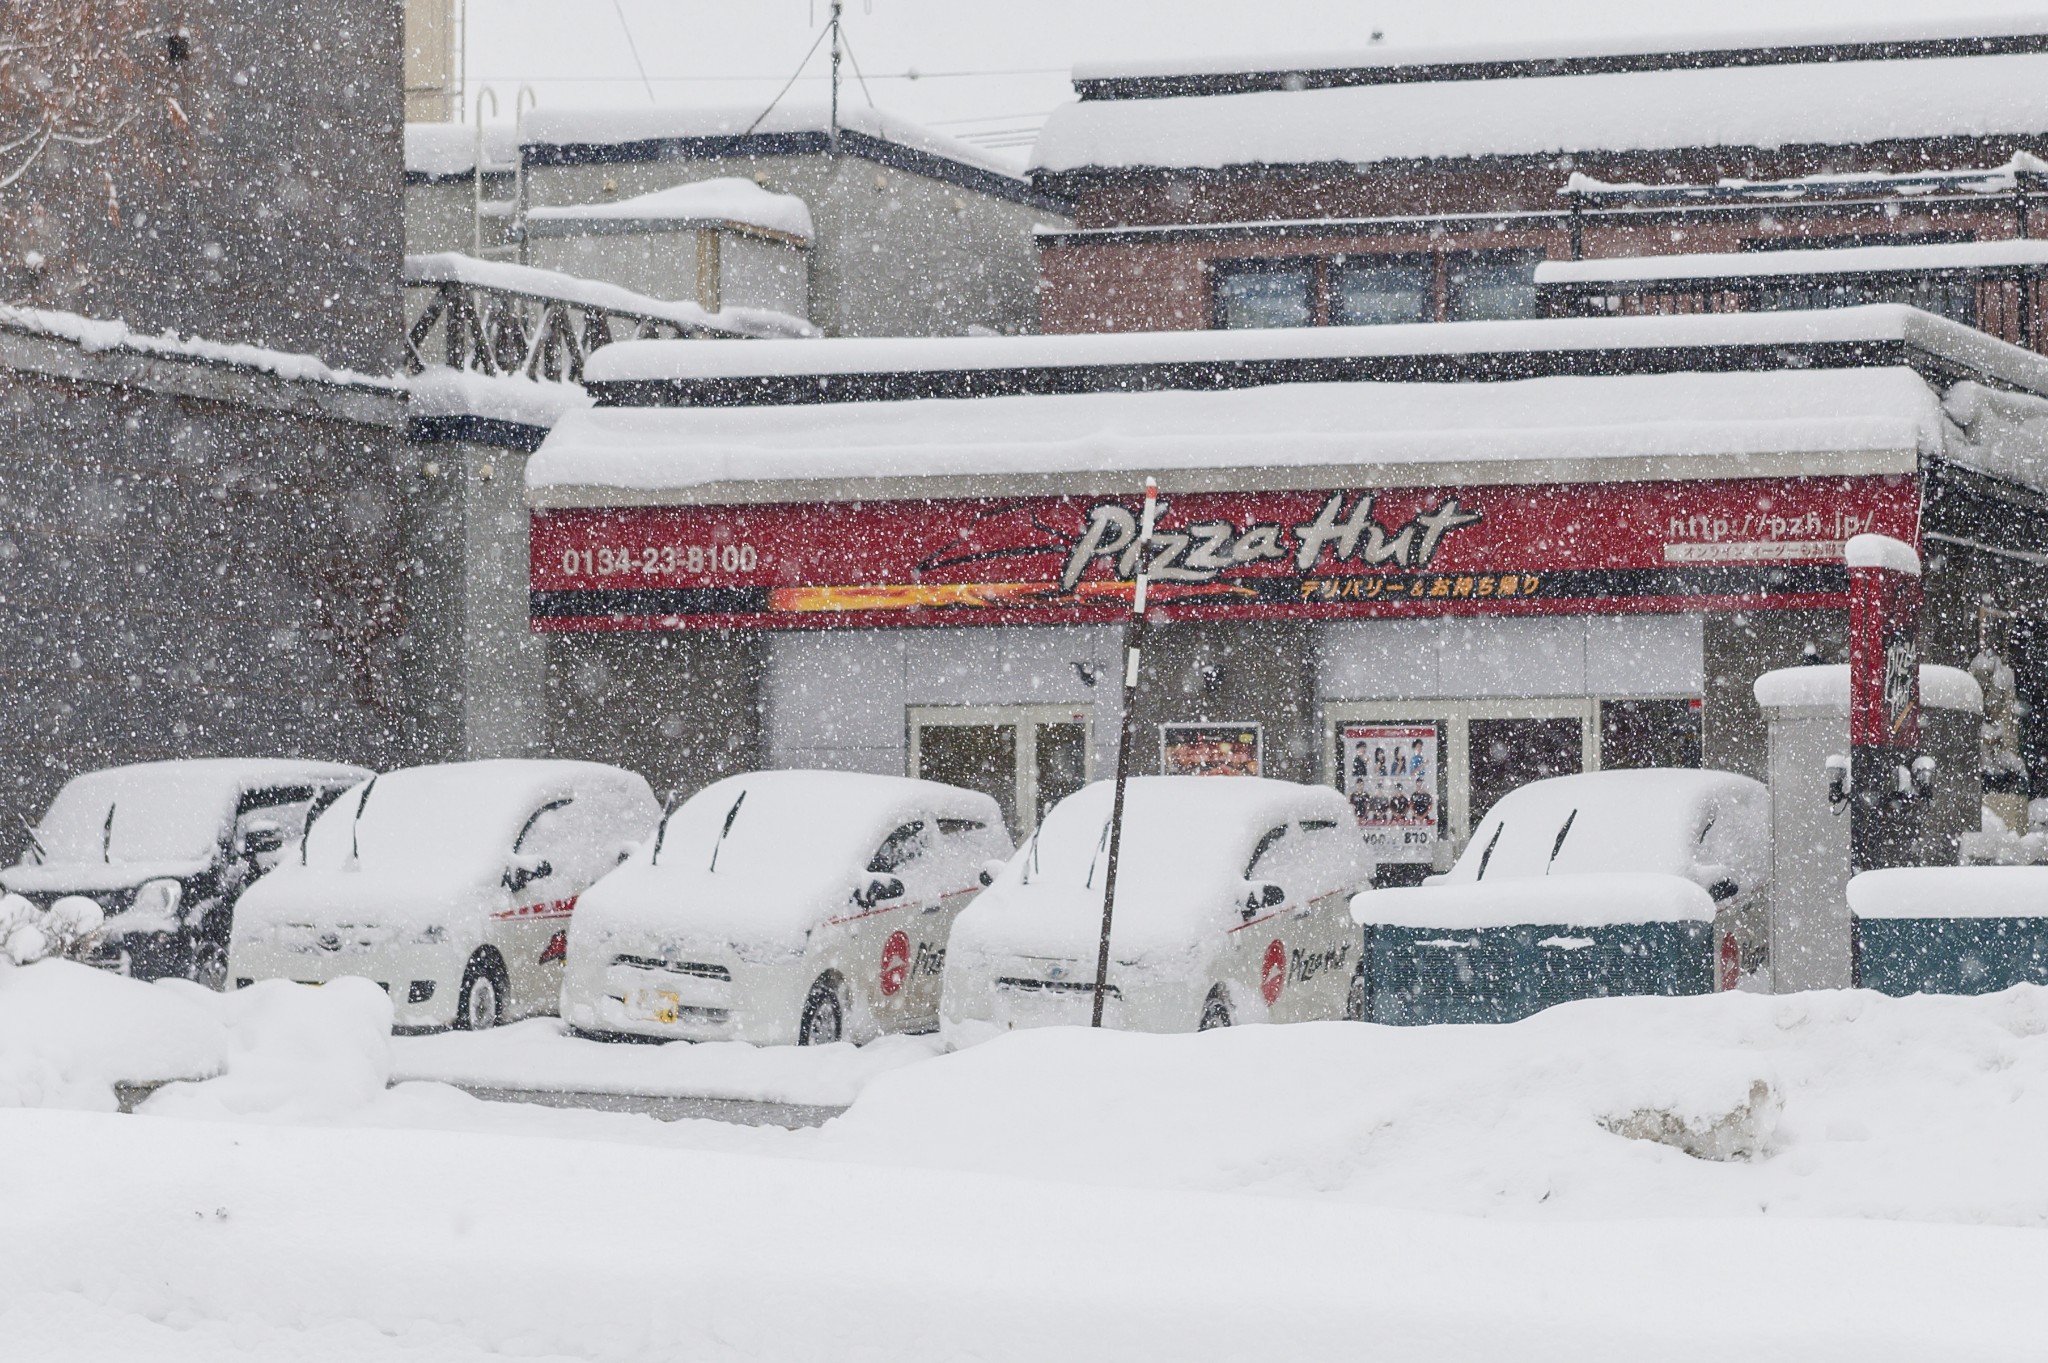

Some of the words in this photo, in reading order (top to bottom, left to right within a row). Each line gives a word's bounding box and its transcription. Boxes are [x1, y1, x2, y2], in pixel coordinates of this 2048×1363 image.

[1669, 510, 1874, 541] http://pzh.jp/
[1063, 500, 1287, 590] Pizza
[1295, 494, 1480, 570] Hut
[561, 545, 757, 577] 0134-23-8100
[1404, 832, 1427, 844] 870
